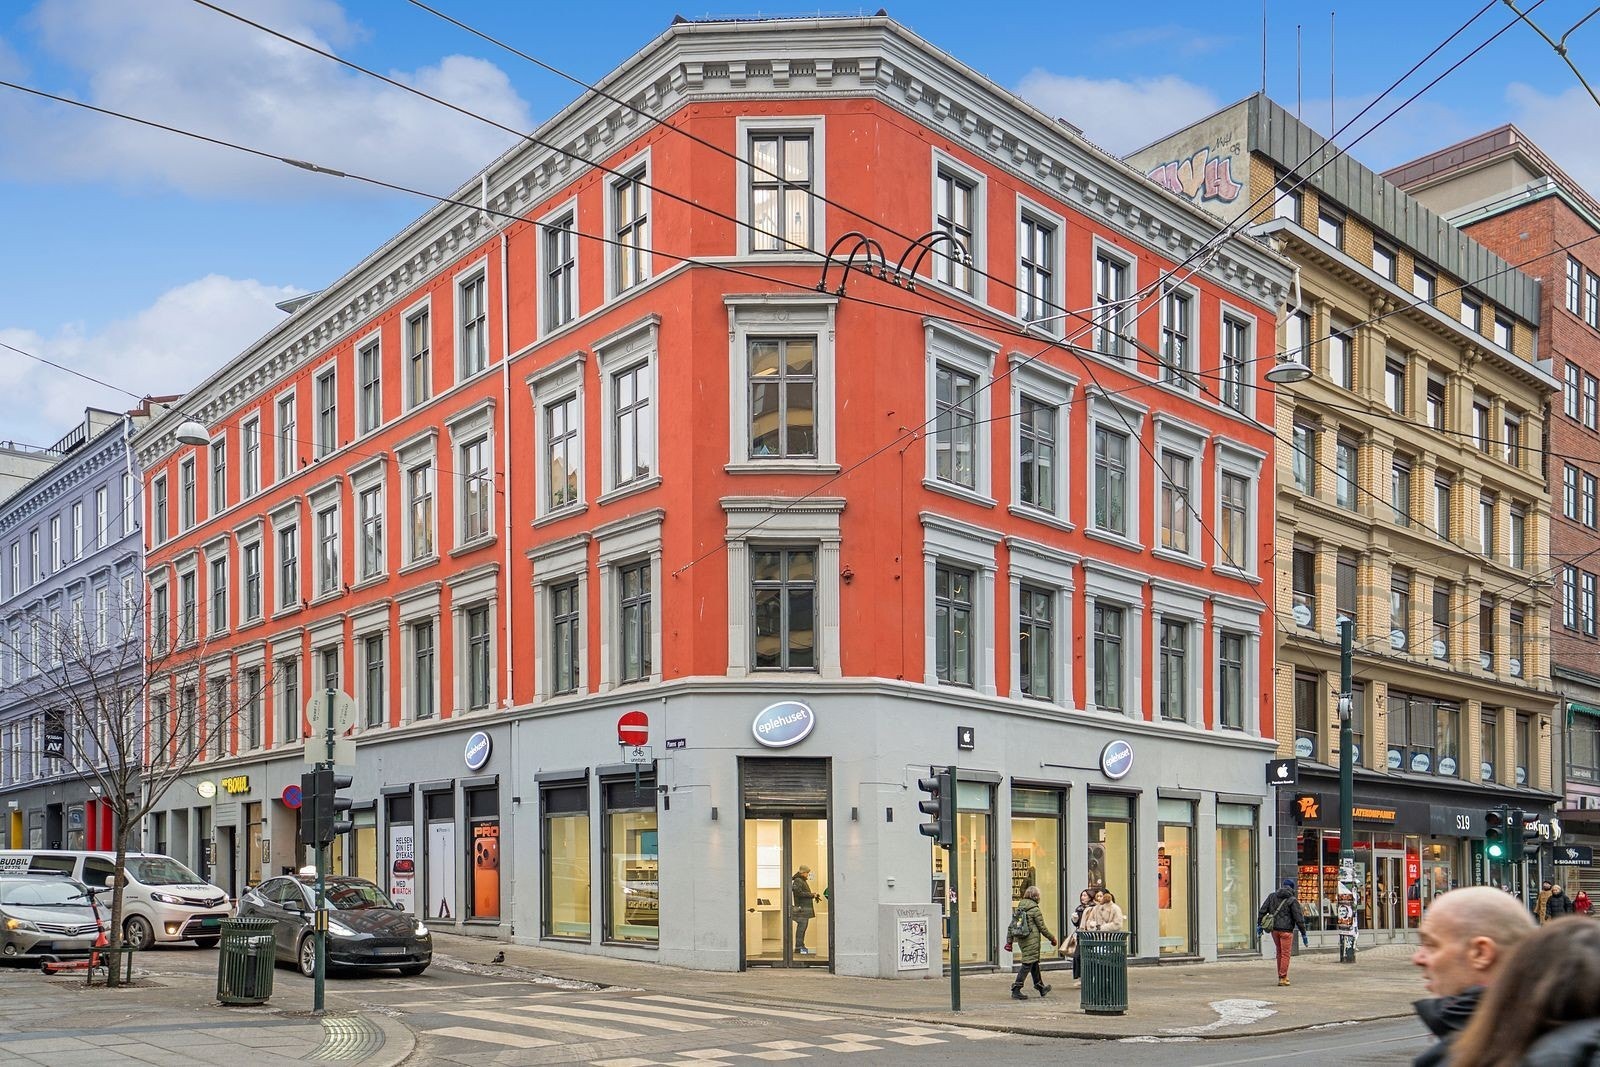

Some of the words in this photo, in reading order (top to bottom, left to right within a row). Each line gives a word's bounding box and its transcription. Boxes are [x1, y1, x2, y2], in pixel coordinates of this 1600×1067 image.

[759, 709, 807, 733] eplehuset
[1106, 748, 1130, 767] eplehuset
[1297, 797, 1319, 818] PK
[1352, 807, 1396, 820] LATEKOMPANIET
[1456, 814, 1470, 830] S19
[395, 836, 413, 844] HELSEN
[474, 826, 499, 838] PRO
